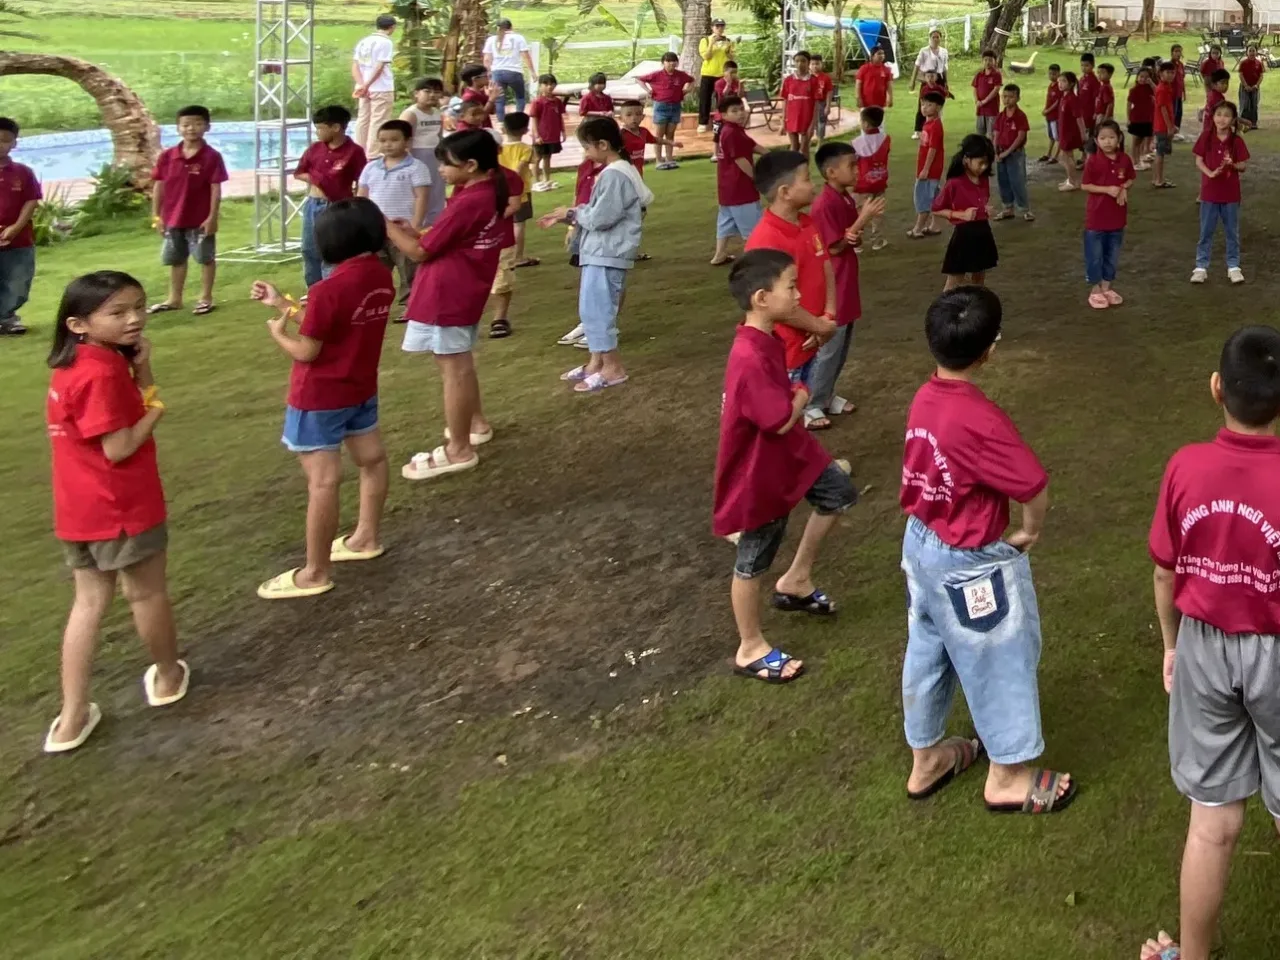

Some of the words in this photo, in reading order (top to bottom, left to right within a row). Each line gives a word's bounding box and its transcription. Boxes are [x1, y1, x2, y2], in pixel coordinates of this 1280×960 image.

[1211, 499, 1234, 515] ANH
[1237, 503, 1264, 525] NGỮ
[1202, 557, 1215, 569] Cho
[1215, 562, 1239, 573] Tương
[1240, 562, 1252, 574] Lai
